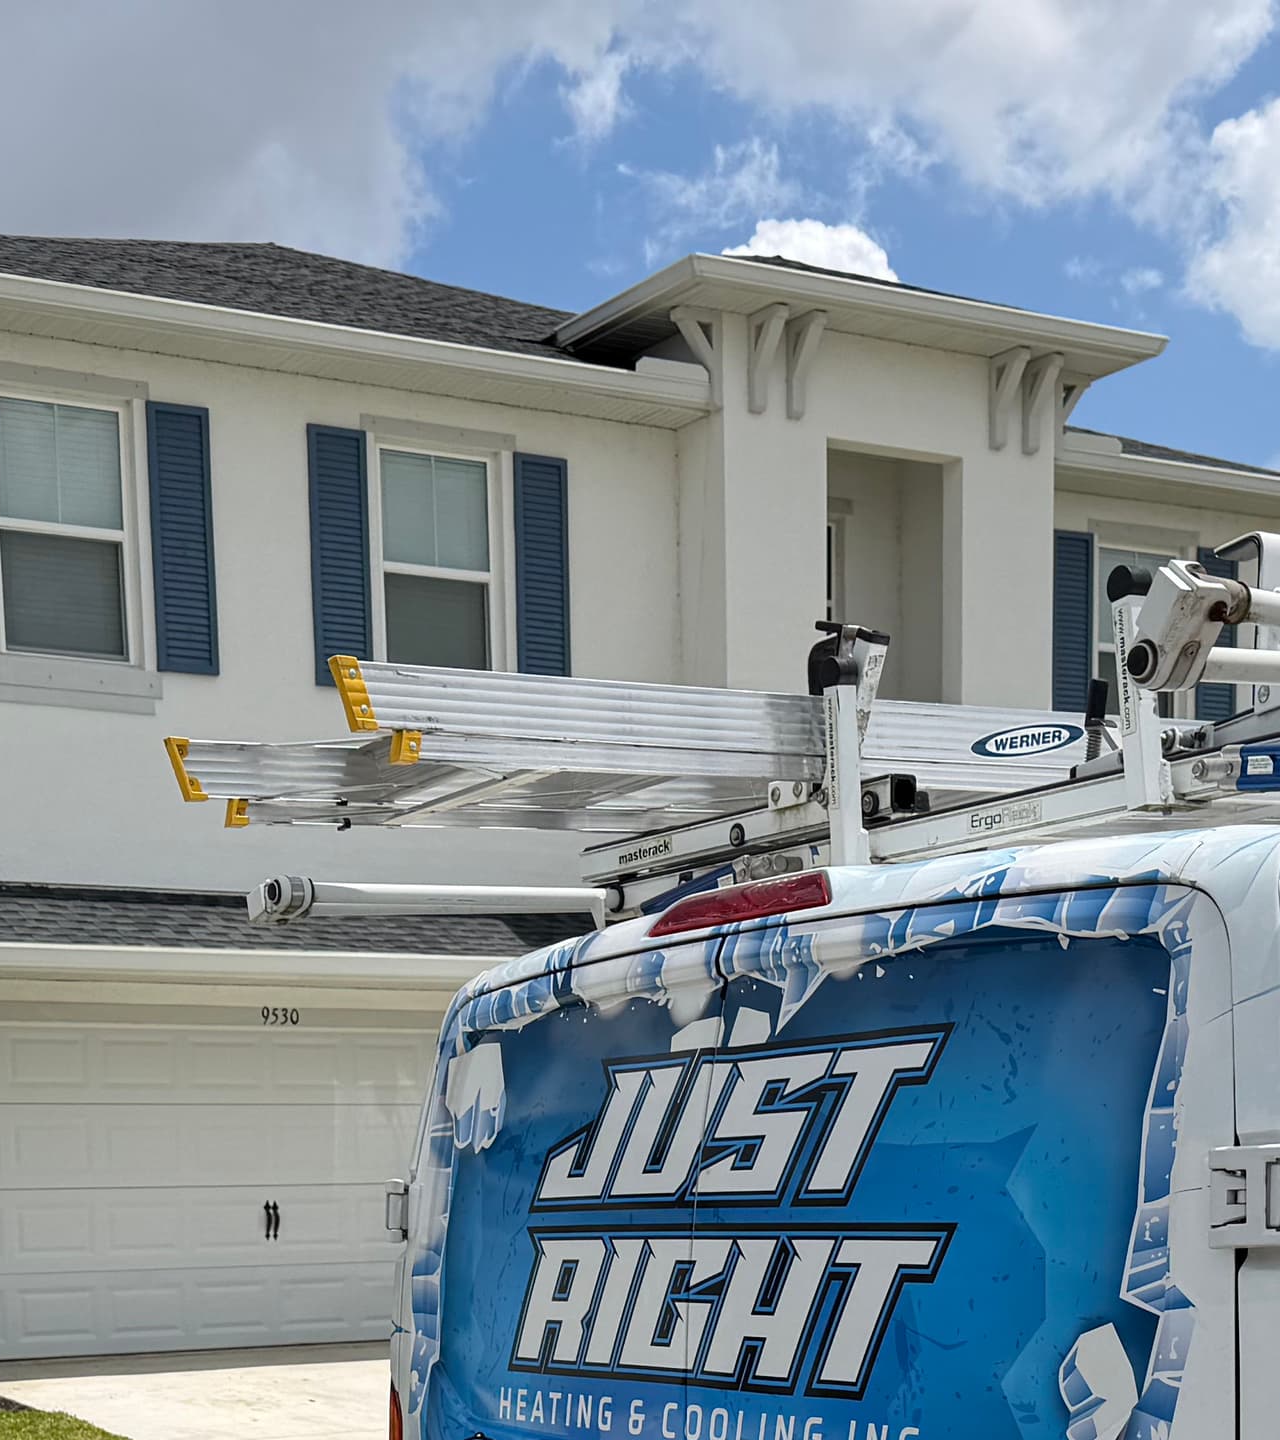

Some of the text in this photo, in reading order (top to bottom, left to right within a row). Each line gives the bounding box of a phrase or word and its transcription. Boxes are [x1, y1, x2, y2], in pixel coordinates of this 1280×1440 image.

[994, 729, 1063, 752] WERNER
[618, 839, 670, 865] masterack
[261, 1006, 300, 1025] 9530
[532, 1030, 947, 1207] JUST
[512, 1229, 949, 1392] RIGHT
[499, 1386, 613, 1432] HEATING
[628, 1400, 645, 1436] &
